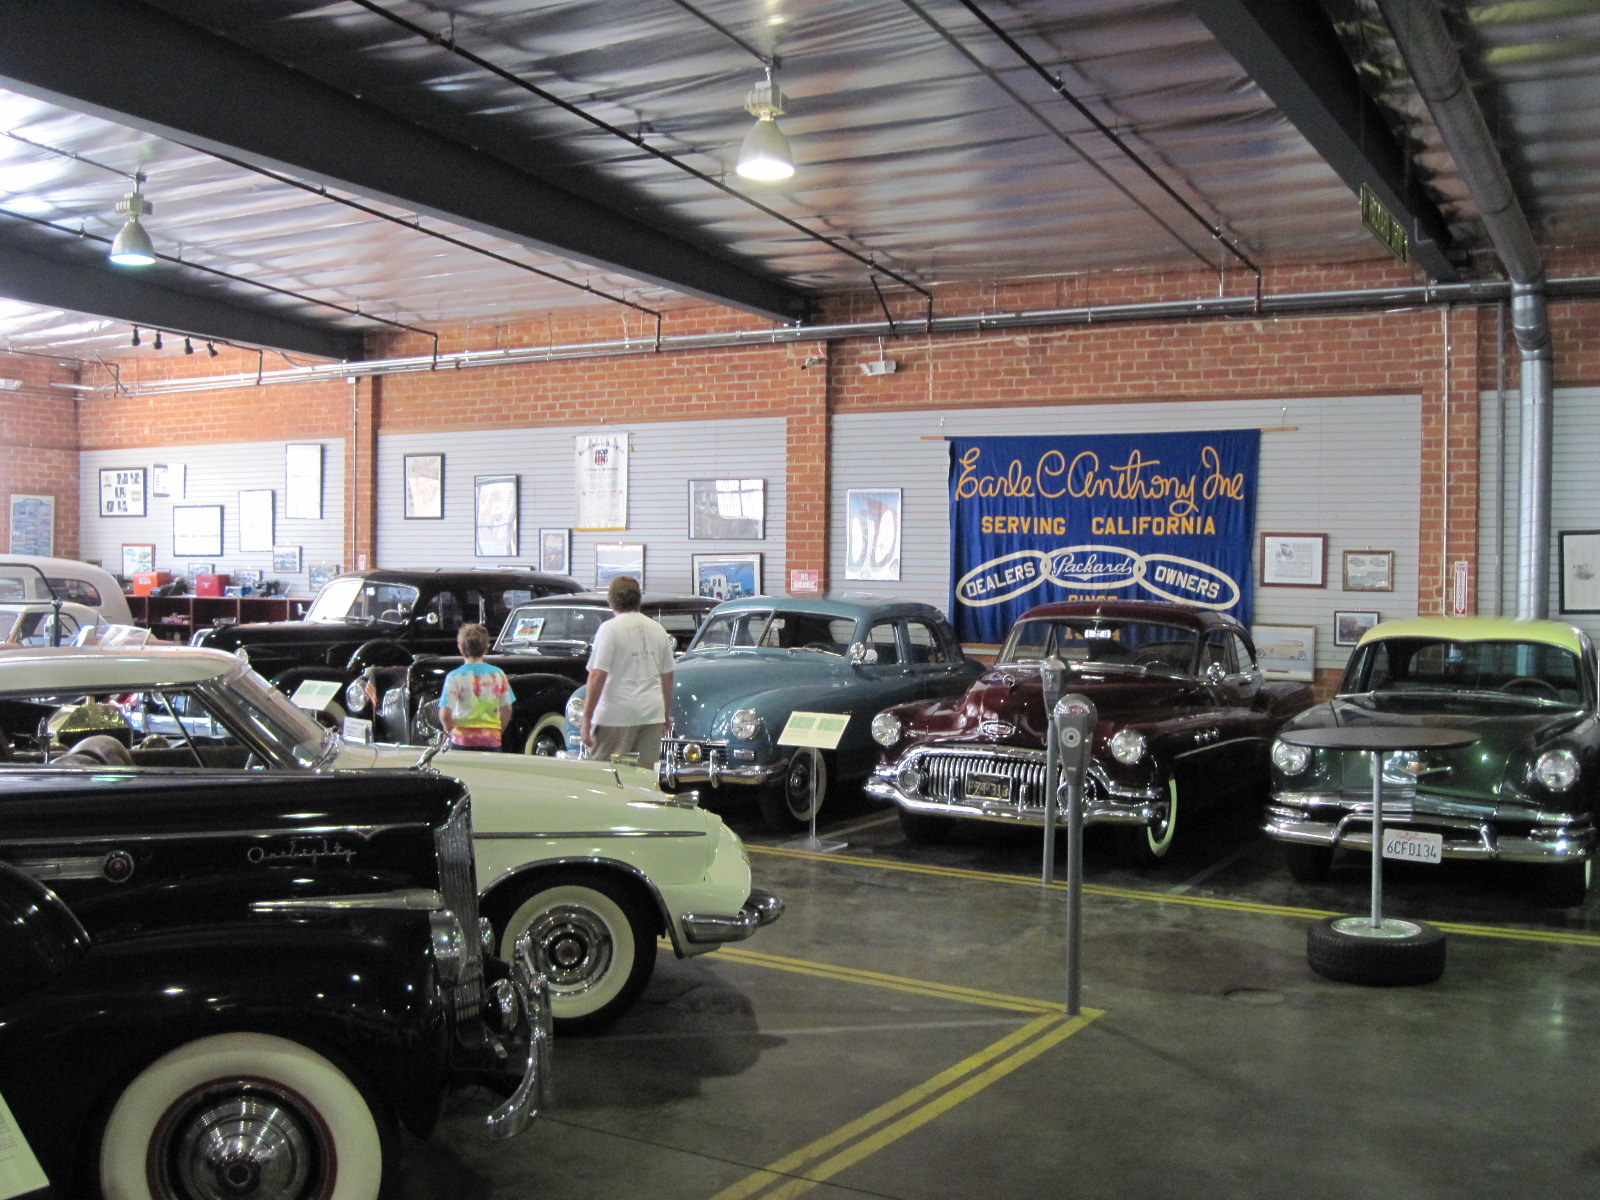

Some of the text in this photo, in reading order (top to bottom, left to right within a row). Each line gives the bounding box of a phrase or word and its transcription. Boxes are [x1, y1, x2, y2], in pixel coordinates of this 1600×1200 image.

[955, 447, 1035, 501] Earle
[1036, 450, 1066, 498] C
[1068, 449, 1199, 517] Anthony
[981, 516, 1217, 536] SERVING CALIFORNIA
[800, 573, 809, 581] NO
[966, 553, 1220, 599] DEALERS Packard OWNERS
[990, 783, 1009, 798] 313
[1386, 840, 1437, 858] 6CFD134
